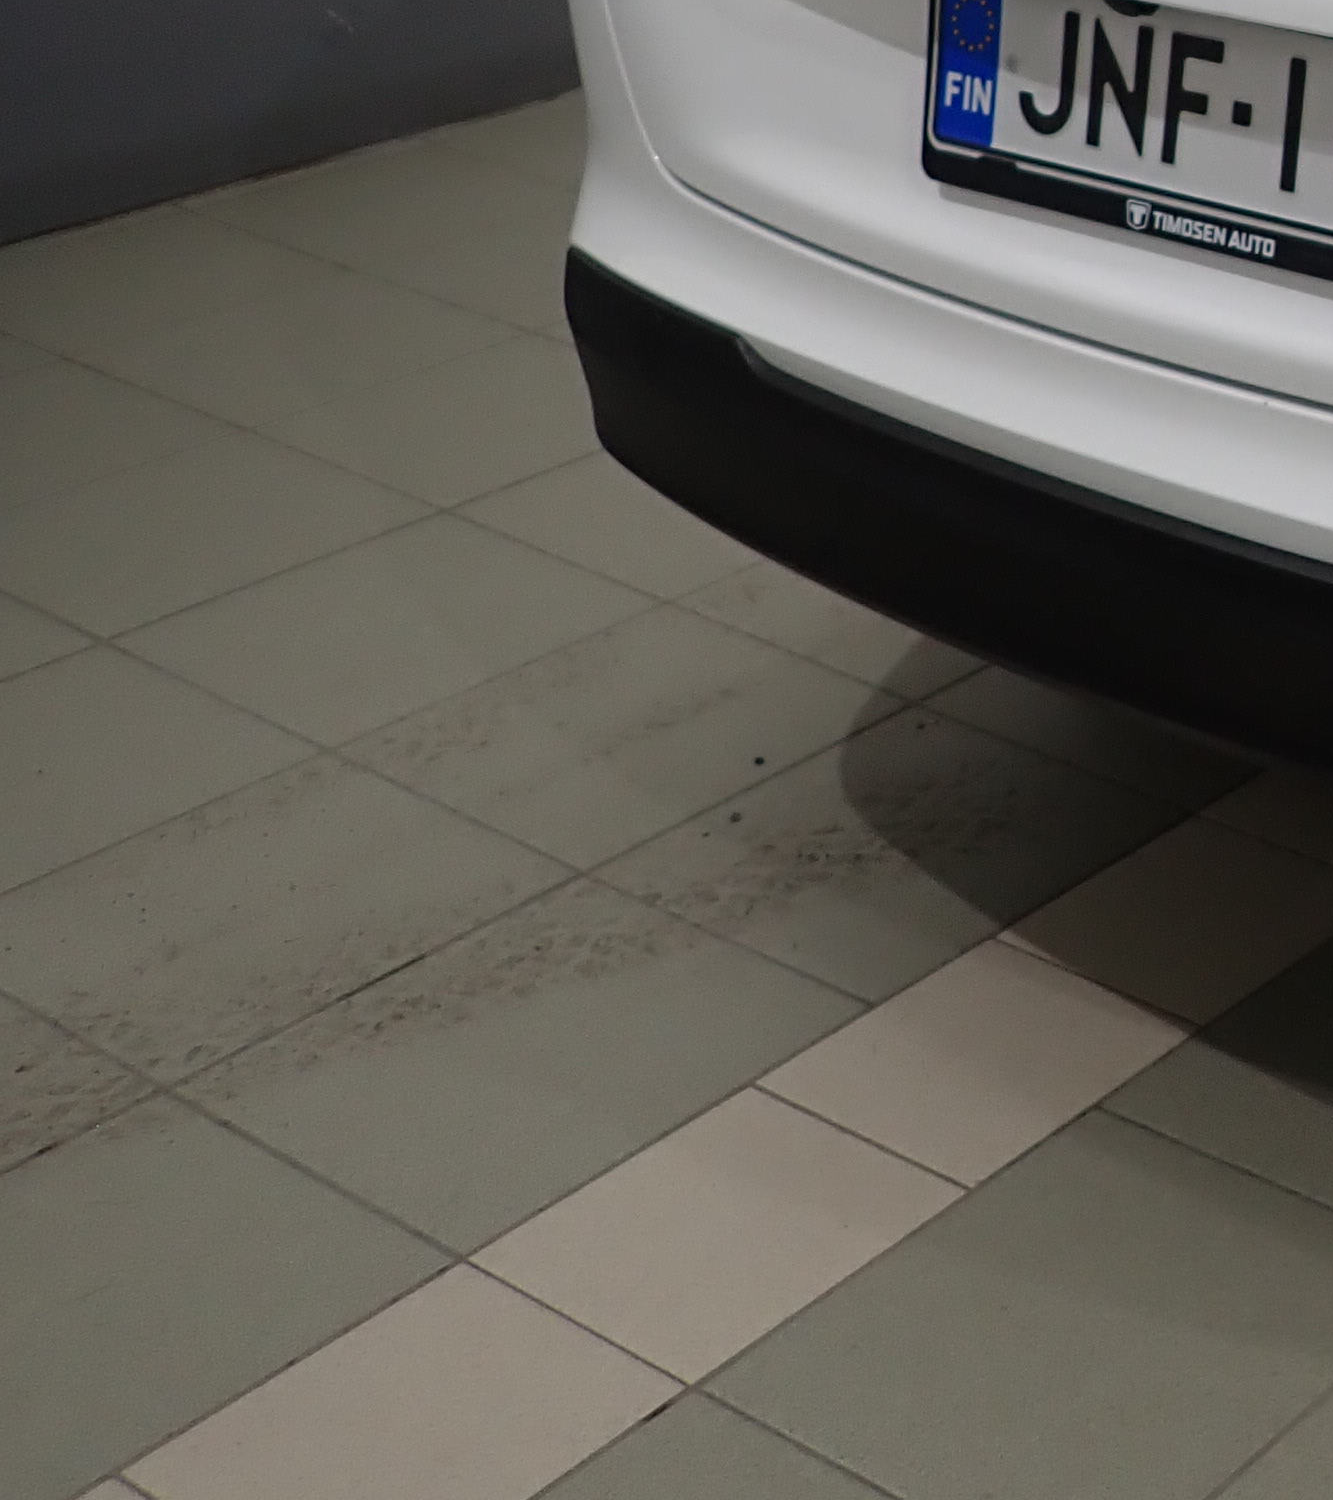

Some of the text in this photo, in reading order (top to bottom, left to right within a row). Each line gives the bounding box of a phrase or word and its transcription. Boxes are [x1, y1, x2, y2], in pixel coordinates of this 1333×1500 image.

[944, 71, 993, 117] FIN
[1152, 210, 1276, 258] TIMOSEN AUTO
